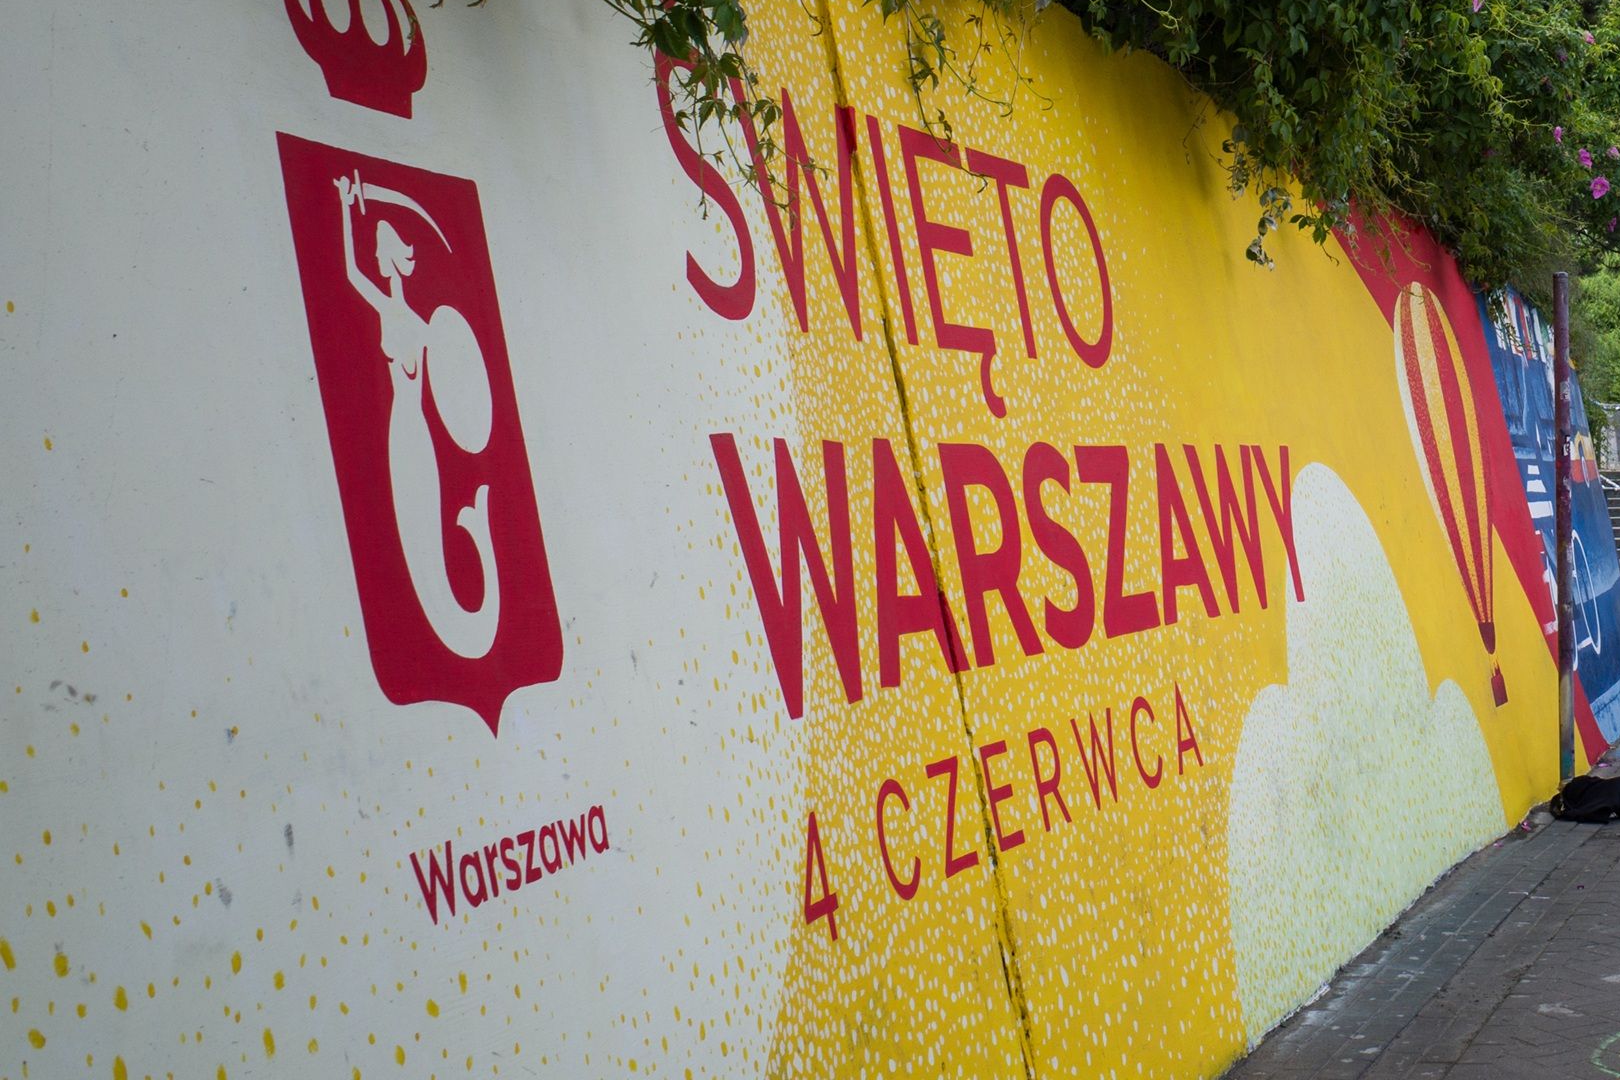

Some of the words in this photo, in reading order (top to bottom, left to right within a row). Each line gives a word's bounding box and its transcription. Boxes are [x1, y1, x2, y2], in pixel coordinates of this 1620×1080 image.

[709, 432, 1305, 720] WARSZAWY
[410, 804, 611, 925] Warszawa
[803, 811, 839, 941] 4
[876, 680, 1203, 902] CZERWCA
